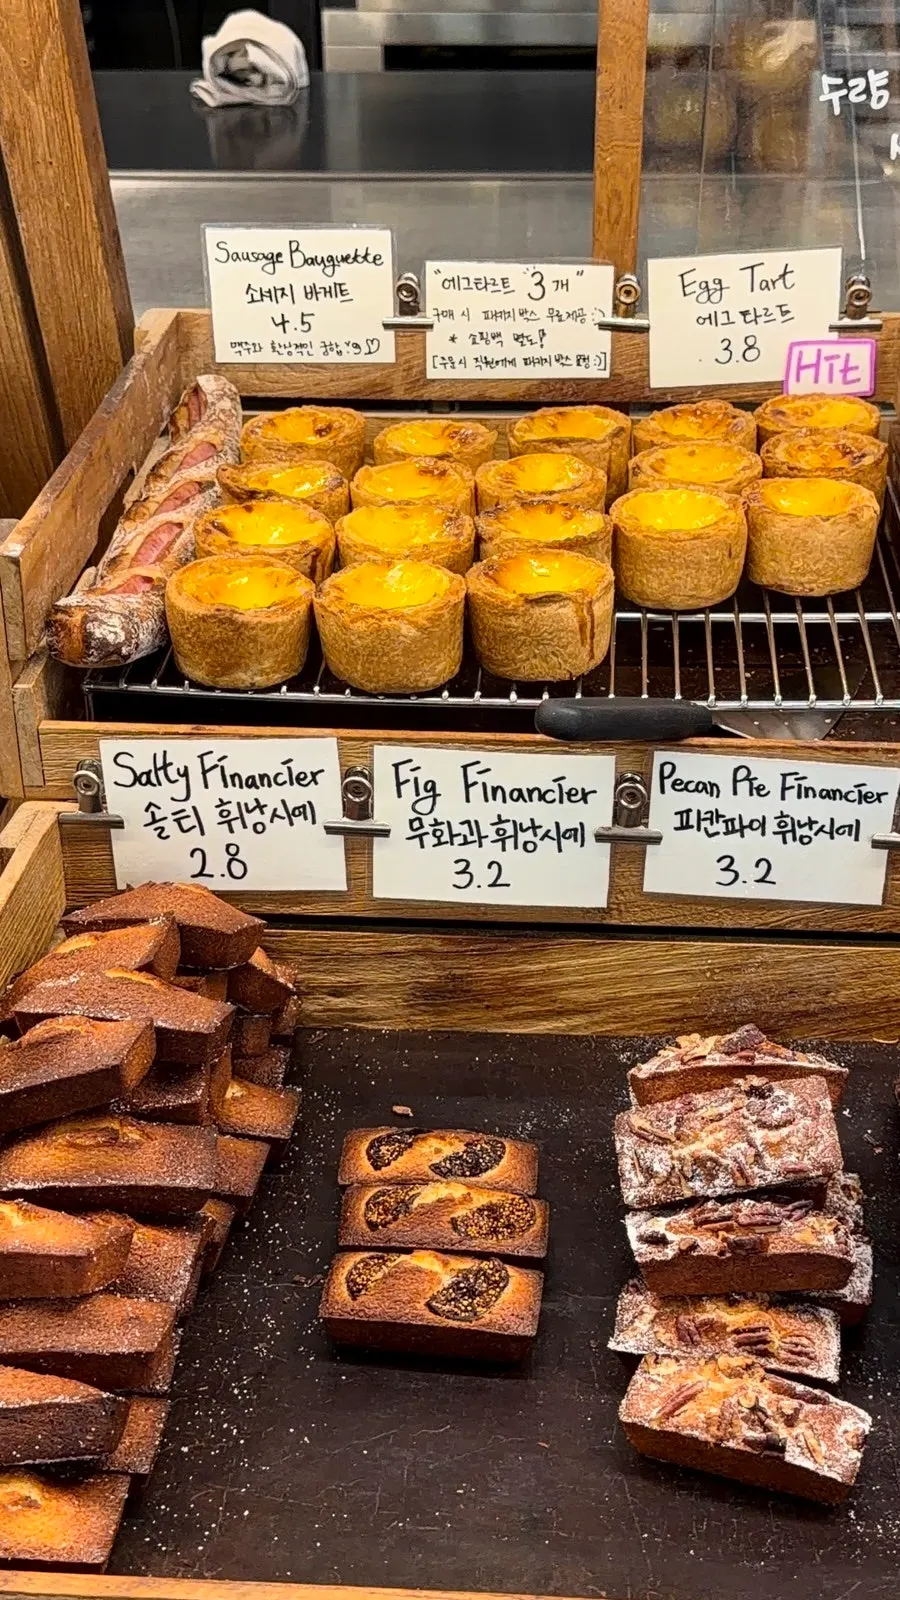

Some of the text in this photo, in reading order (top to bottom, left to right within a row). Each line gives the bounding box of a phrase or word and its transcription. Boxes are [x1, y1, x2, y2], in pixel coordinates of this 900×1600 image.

[215, 241, 284, 275] Sausage
[304, 282, 354, 303] 바게트
[528, 271, 546, 301] 3
[678, 262, 796, 305] Egg Tart
[271, 312, 315, 334] 4.5
[432, 308, 455, 322] 구매
[461, 307, 470, 321] 시
[230, 340, 264, 356] 맥주와
[270, 339, 314, 356] 환상적인
[715, 335, 761, 365] 3.8
[795, 348, 862, 386] Hit
[113, 750, 325, 802] Salty Financier
[391, 758, 598, 816] Fig Financier
[659, 761, 889, 805] Pecan Pie Financier
[143, 798, 316, 840] 솔티 휘낭시에
[189, 843, 248, 880] 2.8
[452, 858, 511, 889] 3.2
[715, 855, 776, 886] 3.2
